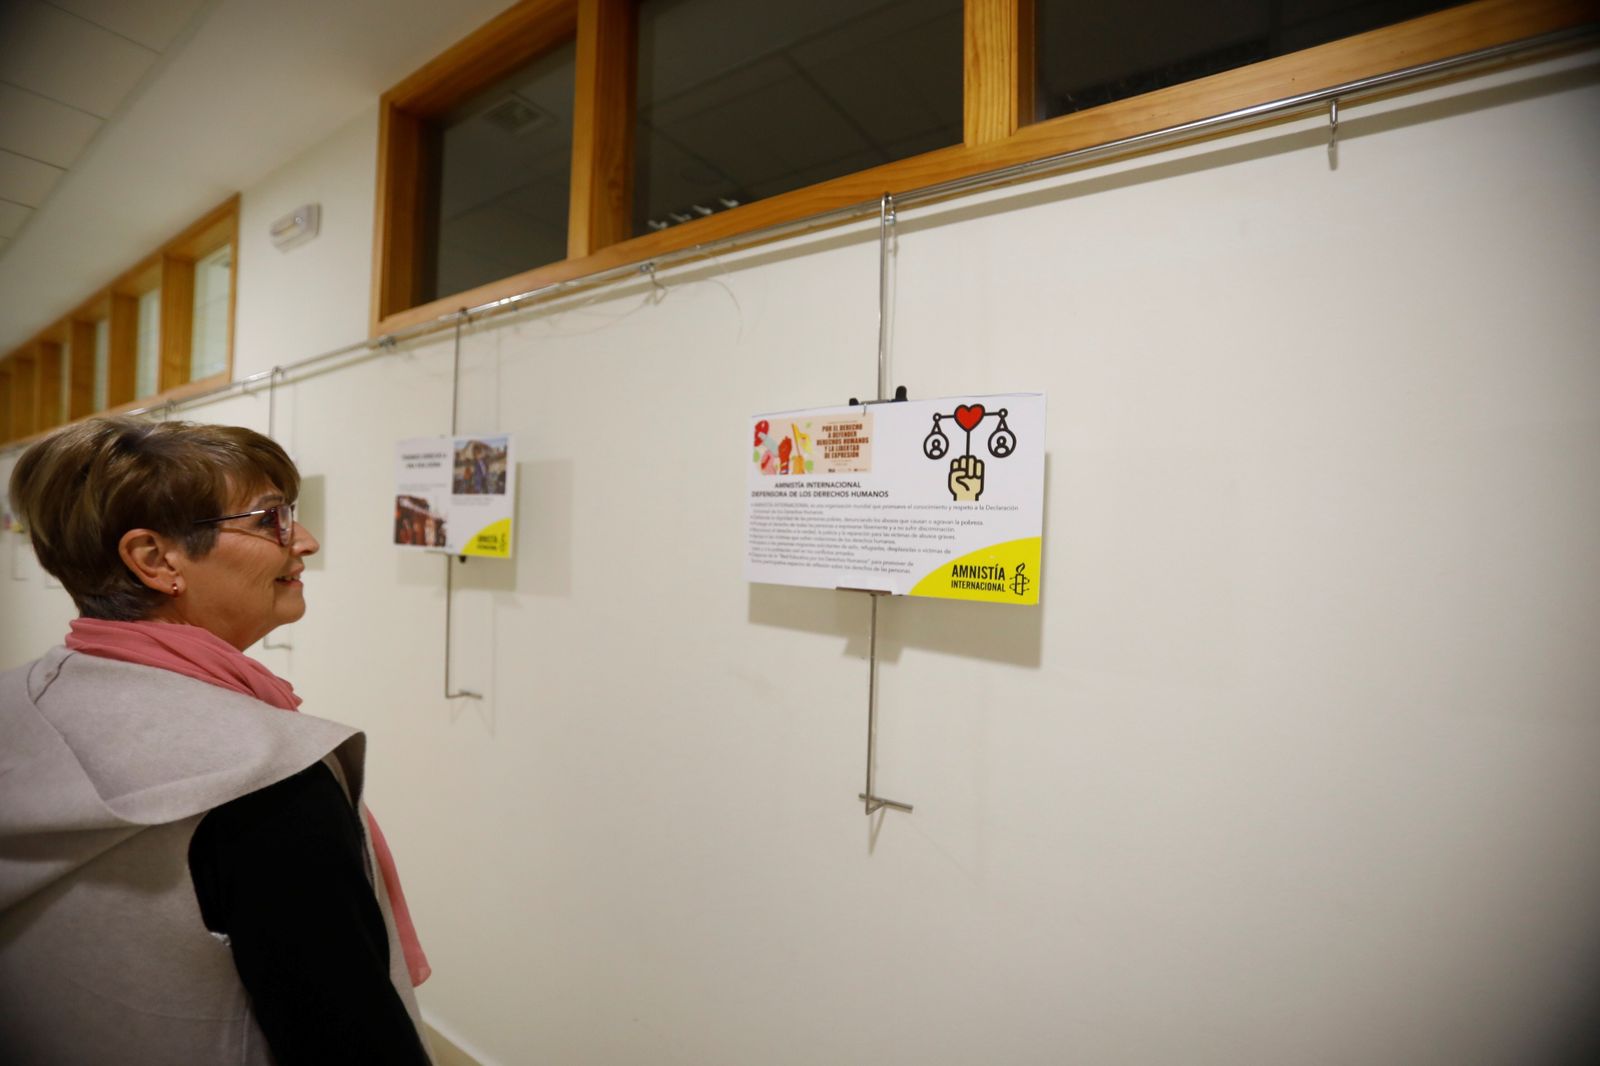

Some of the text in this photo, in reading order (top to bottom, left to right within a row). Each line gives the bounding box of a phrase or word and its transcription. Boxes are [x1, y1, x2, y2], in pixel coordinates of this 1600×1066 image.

[840, 423, 863, 431] DERECHO
[816, 438, 842, 446] DERECHOS
[835, 444, 860, 452] LIBERTAD
[831, 451, 859, 459] EXPRESIÓN
[774, 480, 862, 489] AMNISTÍA INTERNACIONAL
[751, 490, 889, 499] DEFENSORA DE LOS DERECHOS HUMANOS
[951, 563, 1006, 581] AMNISTÍA
[951, 580, 1006, 592] INTERNACIONAL
